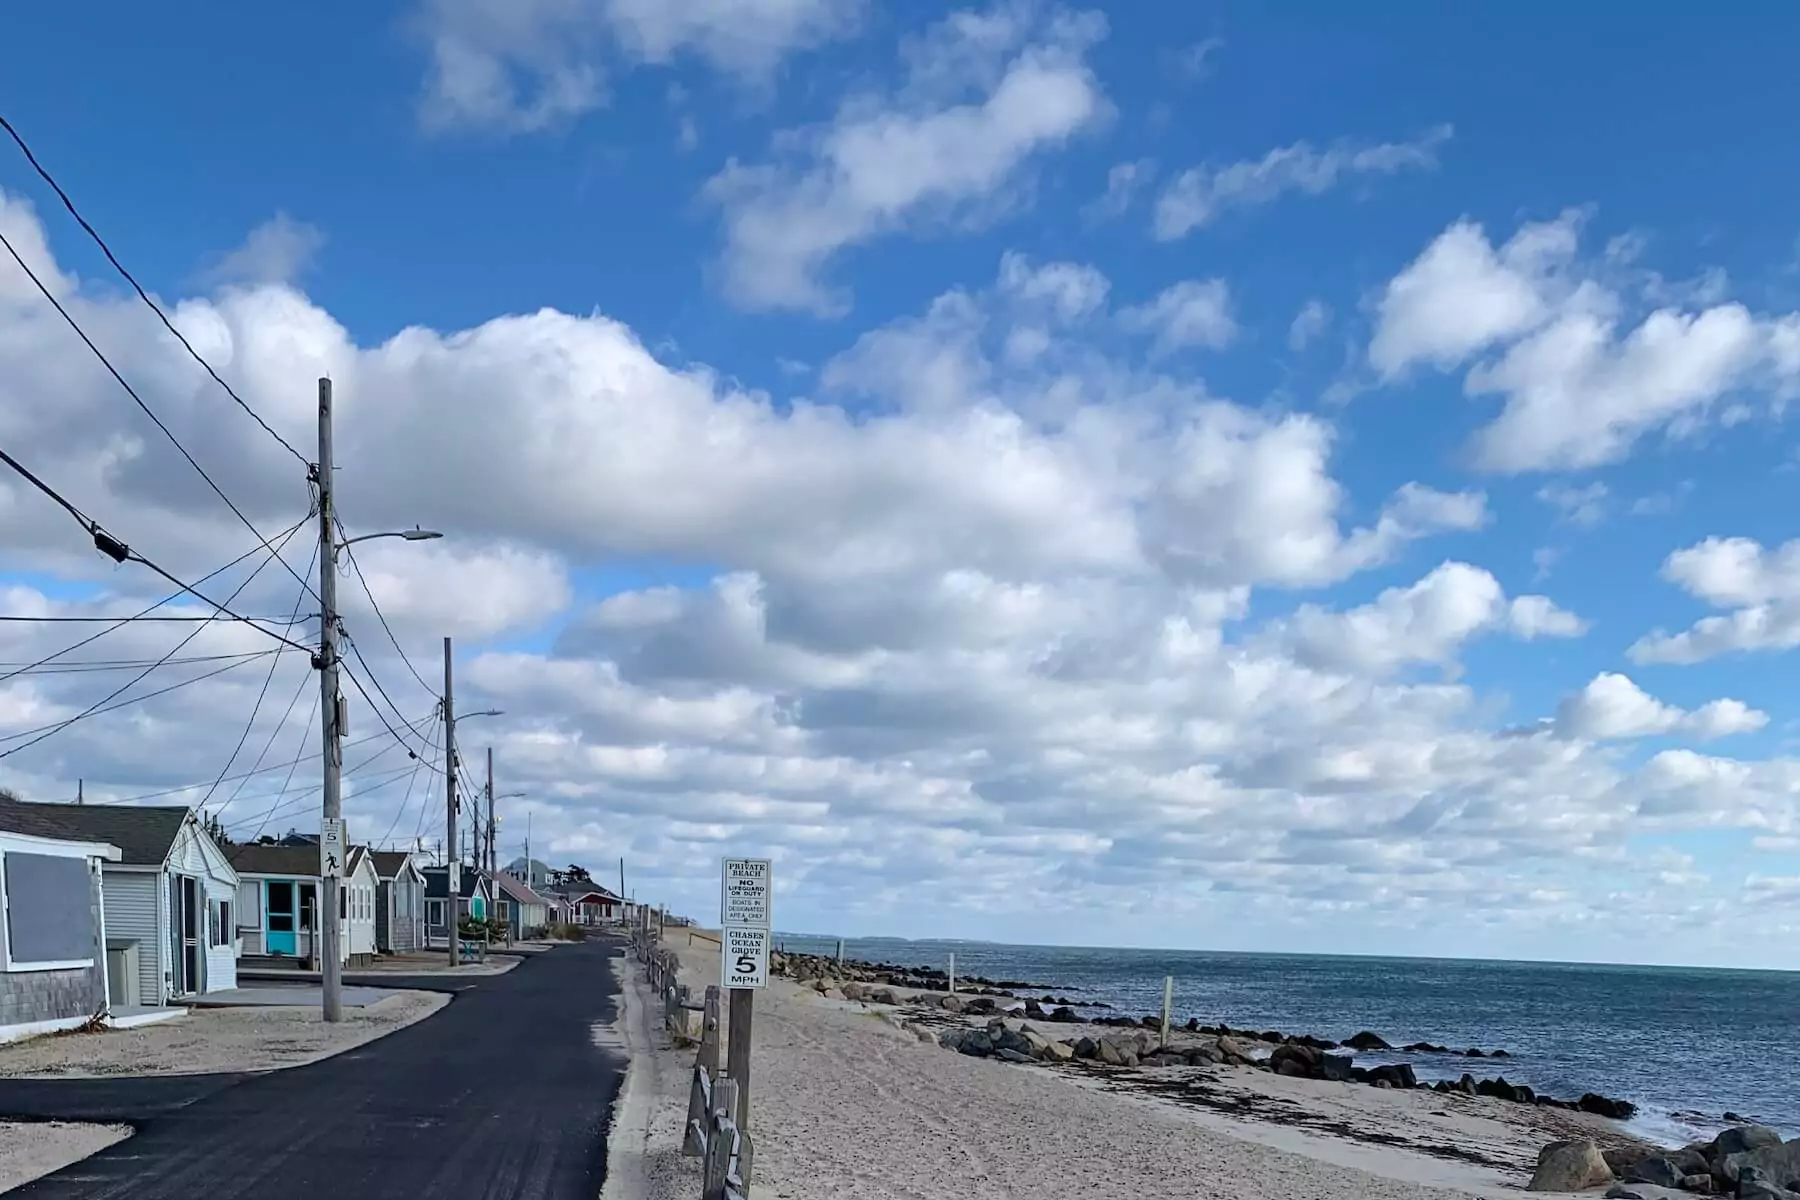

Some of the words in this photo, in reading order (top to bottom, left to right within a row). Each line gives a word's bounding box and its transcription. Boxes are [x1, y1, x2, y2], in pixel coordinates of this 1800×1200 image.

[327, 832, 337, 841] 5
[729, 931, 764, 940] CHASES
[731, 939, 761, 947] OCEAN
[731, 947, 761, 955] GROVE
[735, 956, 756, 973] 5
[731, 976, 759, 984] MPH
